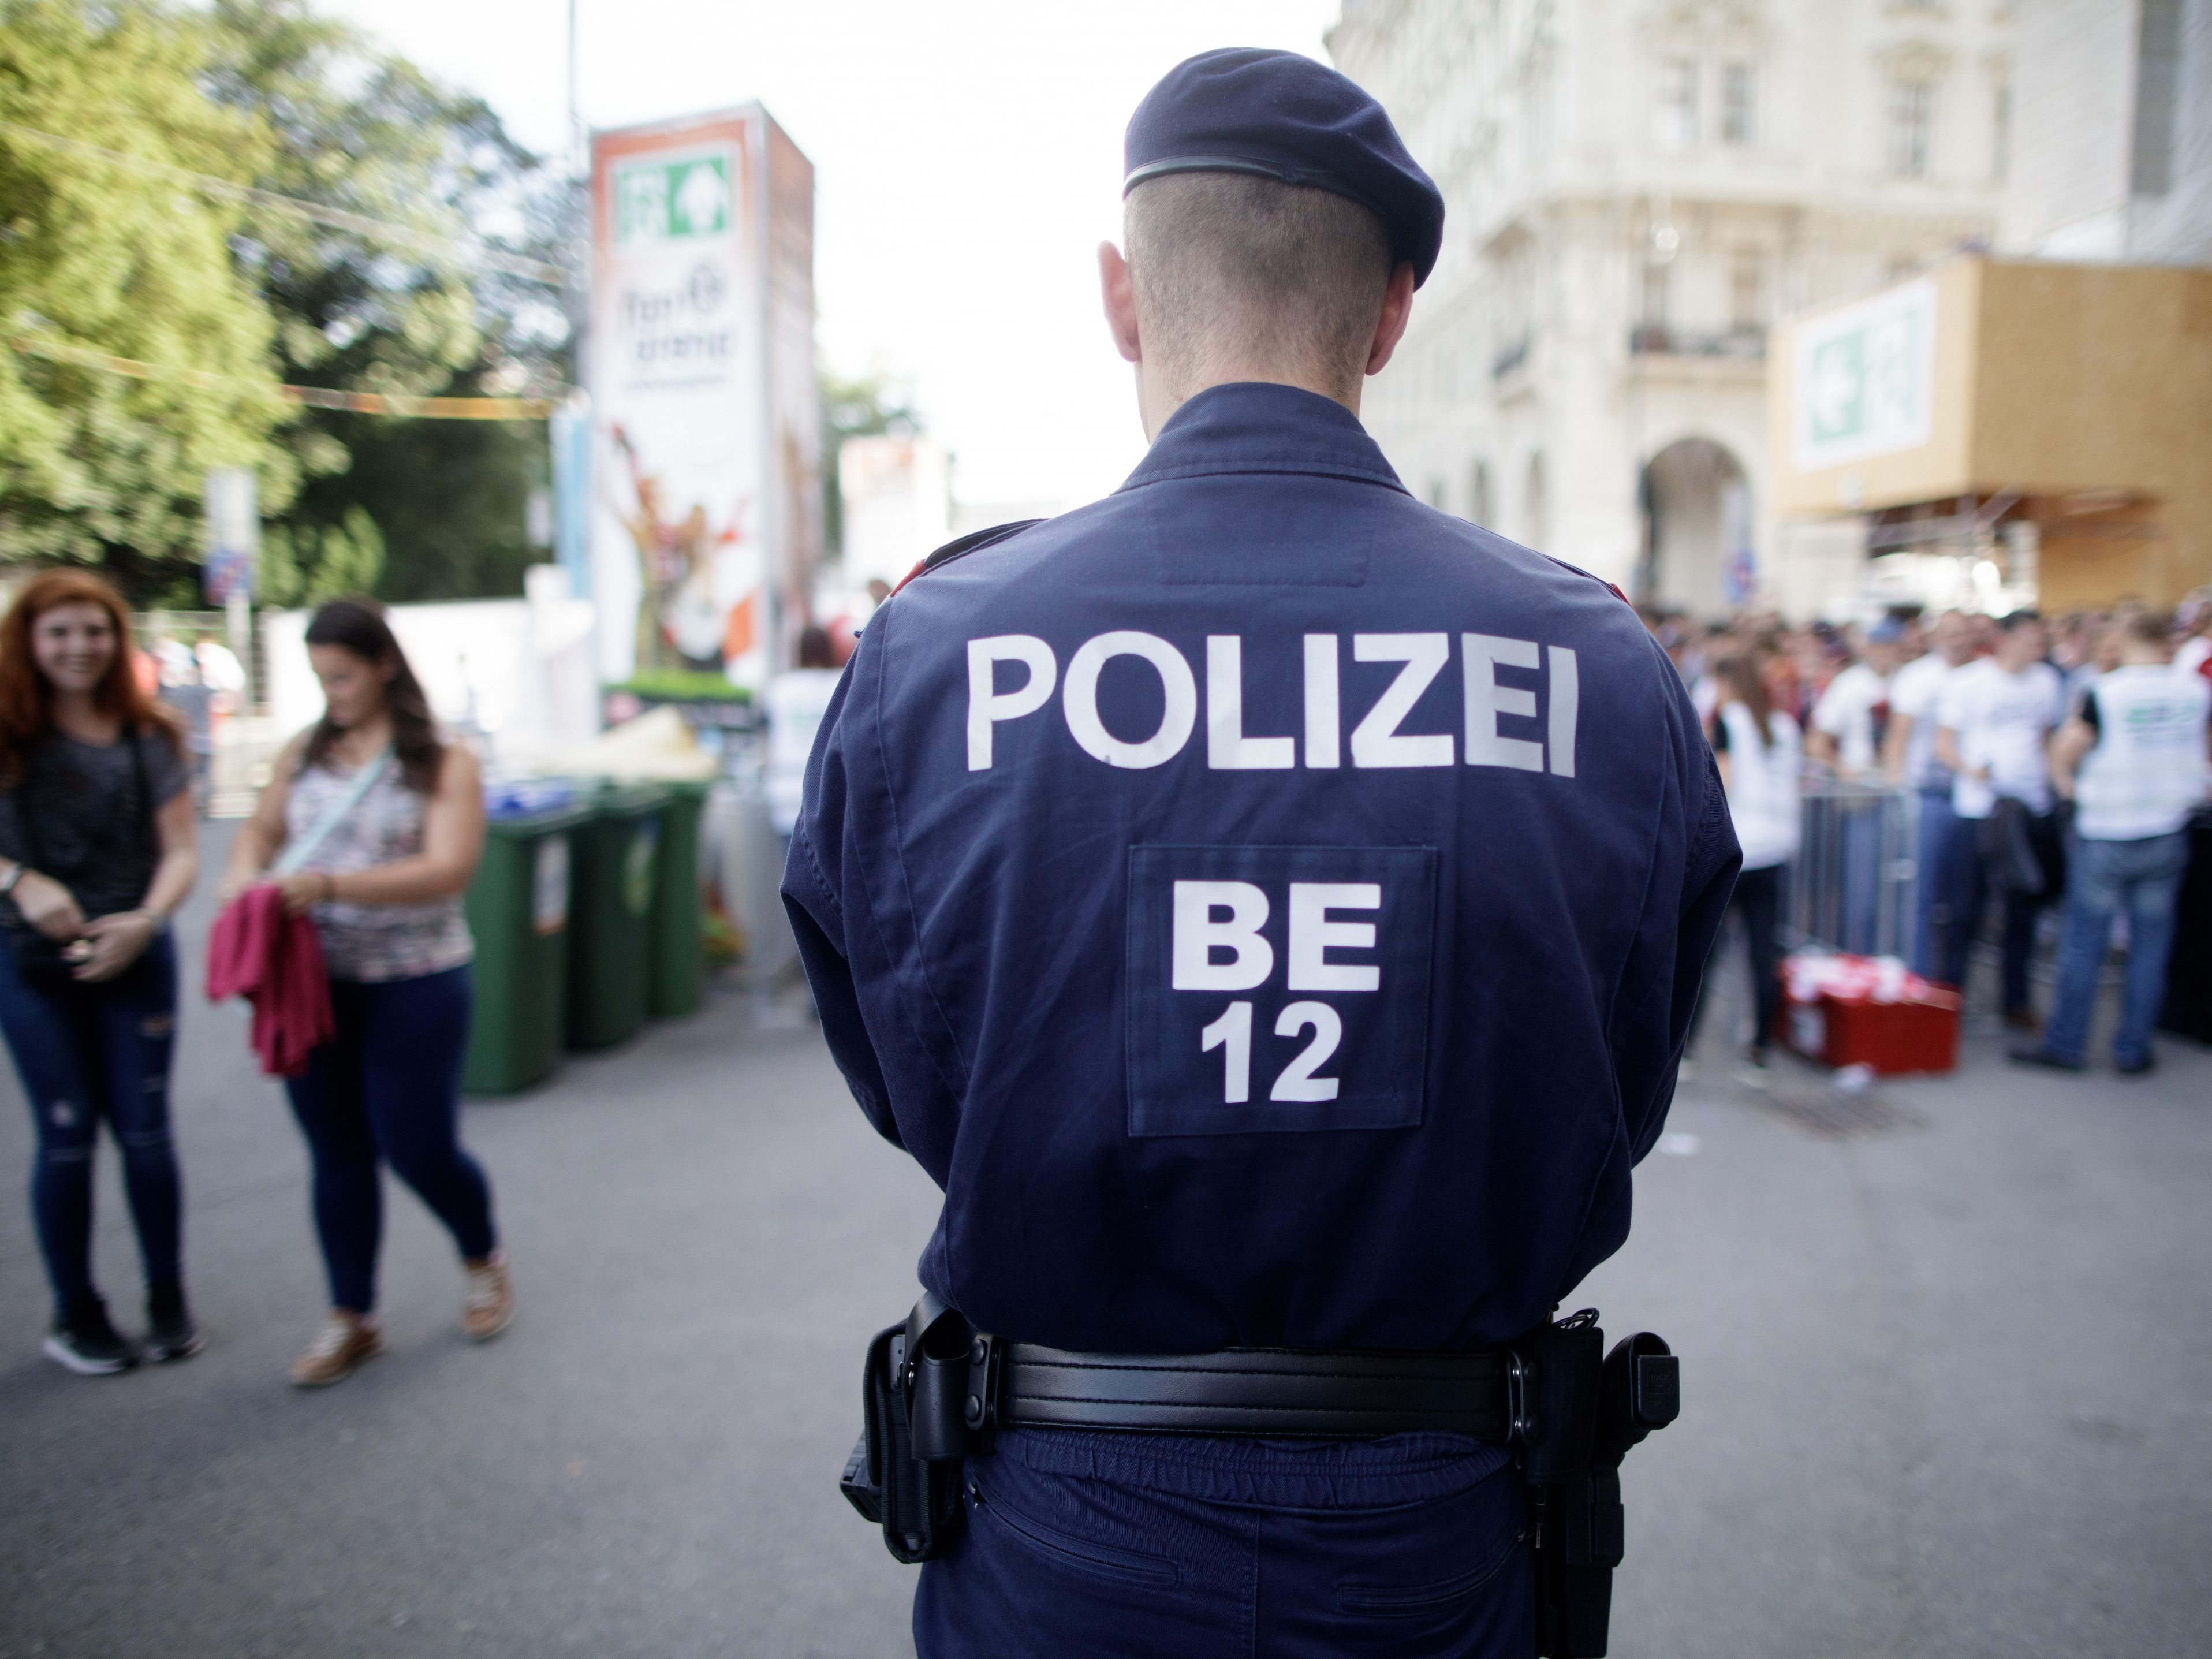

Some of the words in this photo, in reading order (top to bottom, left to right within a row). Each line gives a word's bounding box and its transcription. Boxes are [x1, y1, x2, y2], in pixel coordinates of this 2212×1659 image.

[967, 629, 1579, 778] POLIZEI
[1172, 880, 1381, 991] BE
[1201, 1001, 1342, 1103] 12
